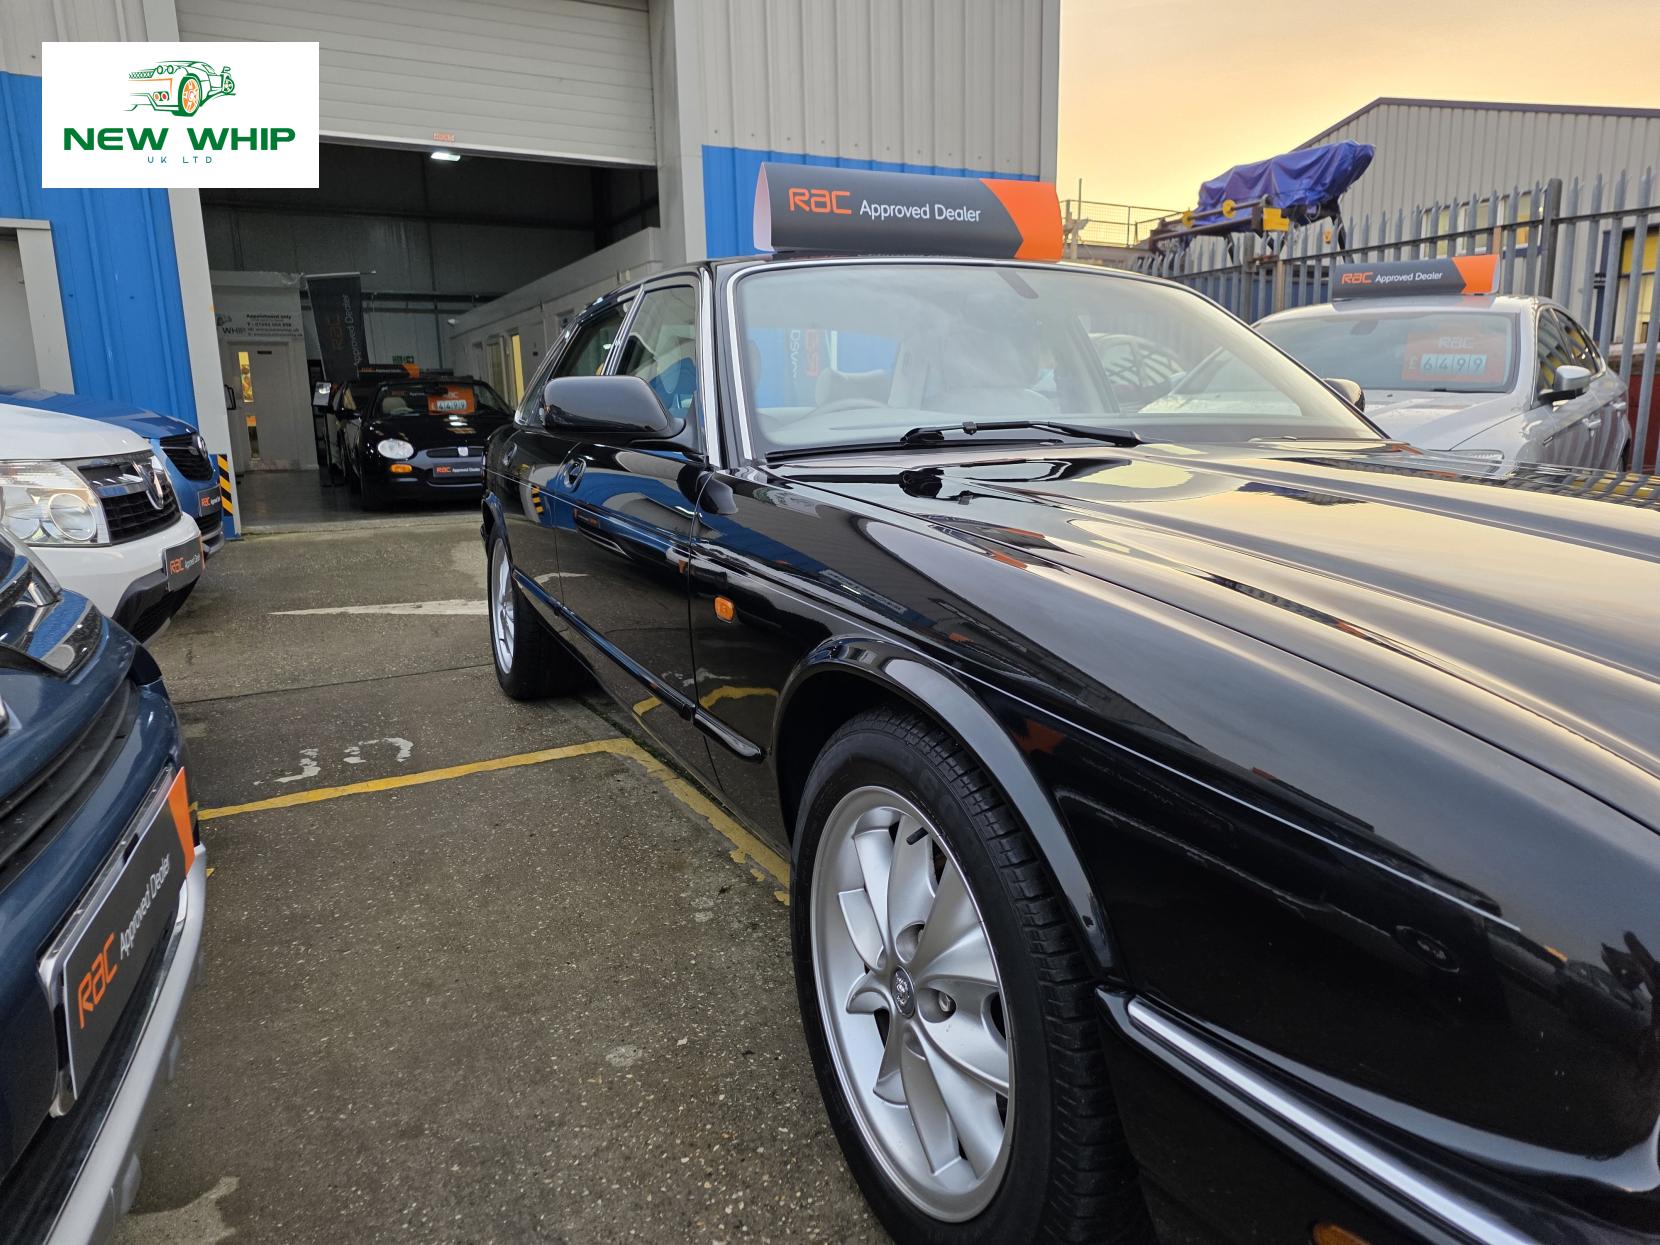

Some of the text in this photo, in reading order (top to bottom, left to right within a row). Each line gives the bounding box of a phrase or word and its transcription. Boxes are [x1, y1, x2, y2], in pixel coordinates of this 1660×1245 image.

[787, 187, 982, 223] RAC Approved Dealer
[1341, 271, 1444, 285] RAC Approved Dealer
[1422, 355, 1485, 371] 6499
[78, 852, 171, 1030] RAC Approved Dealer
